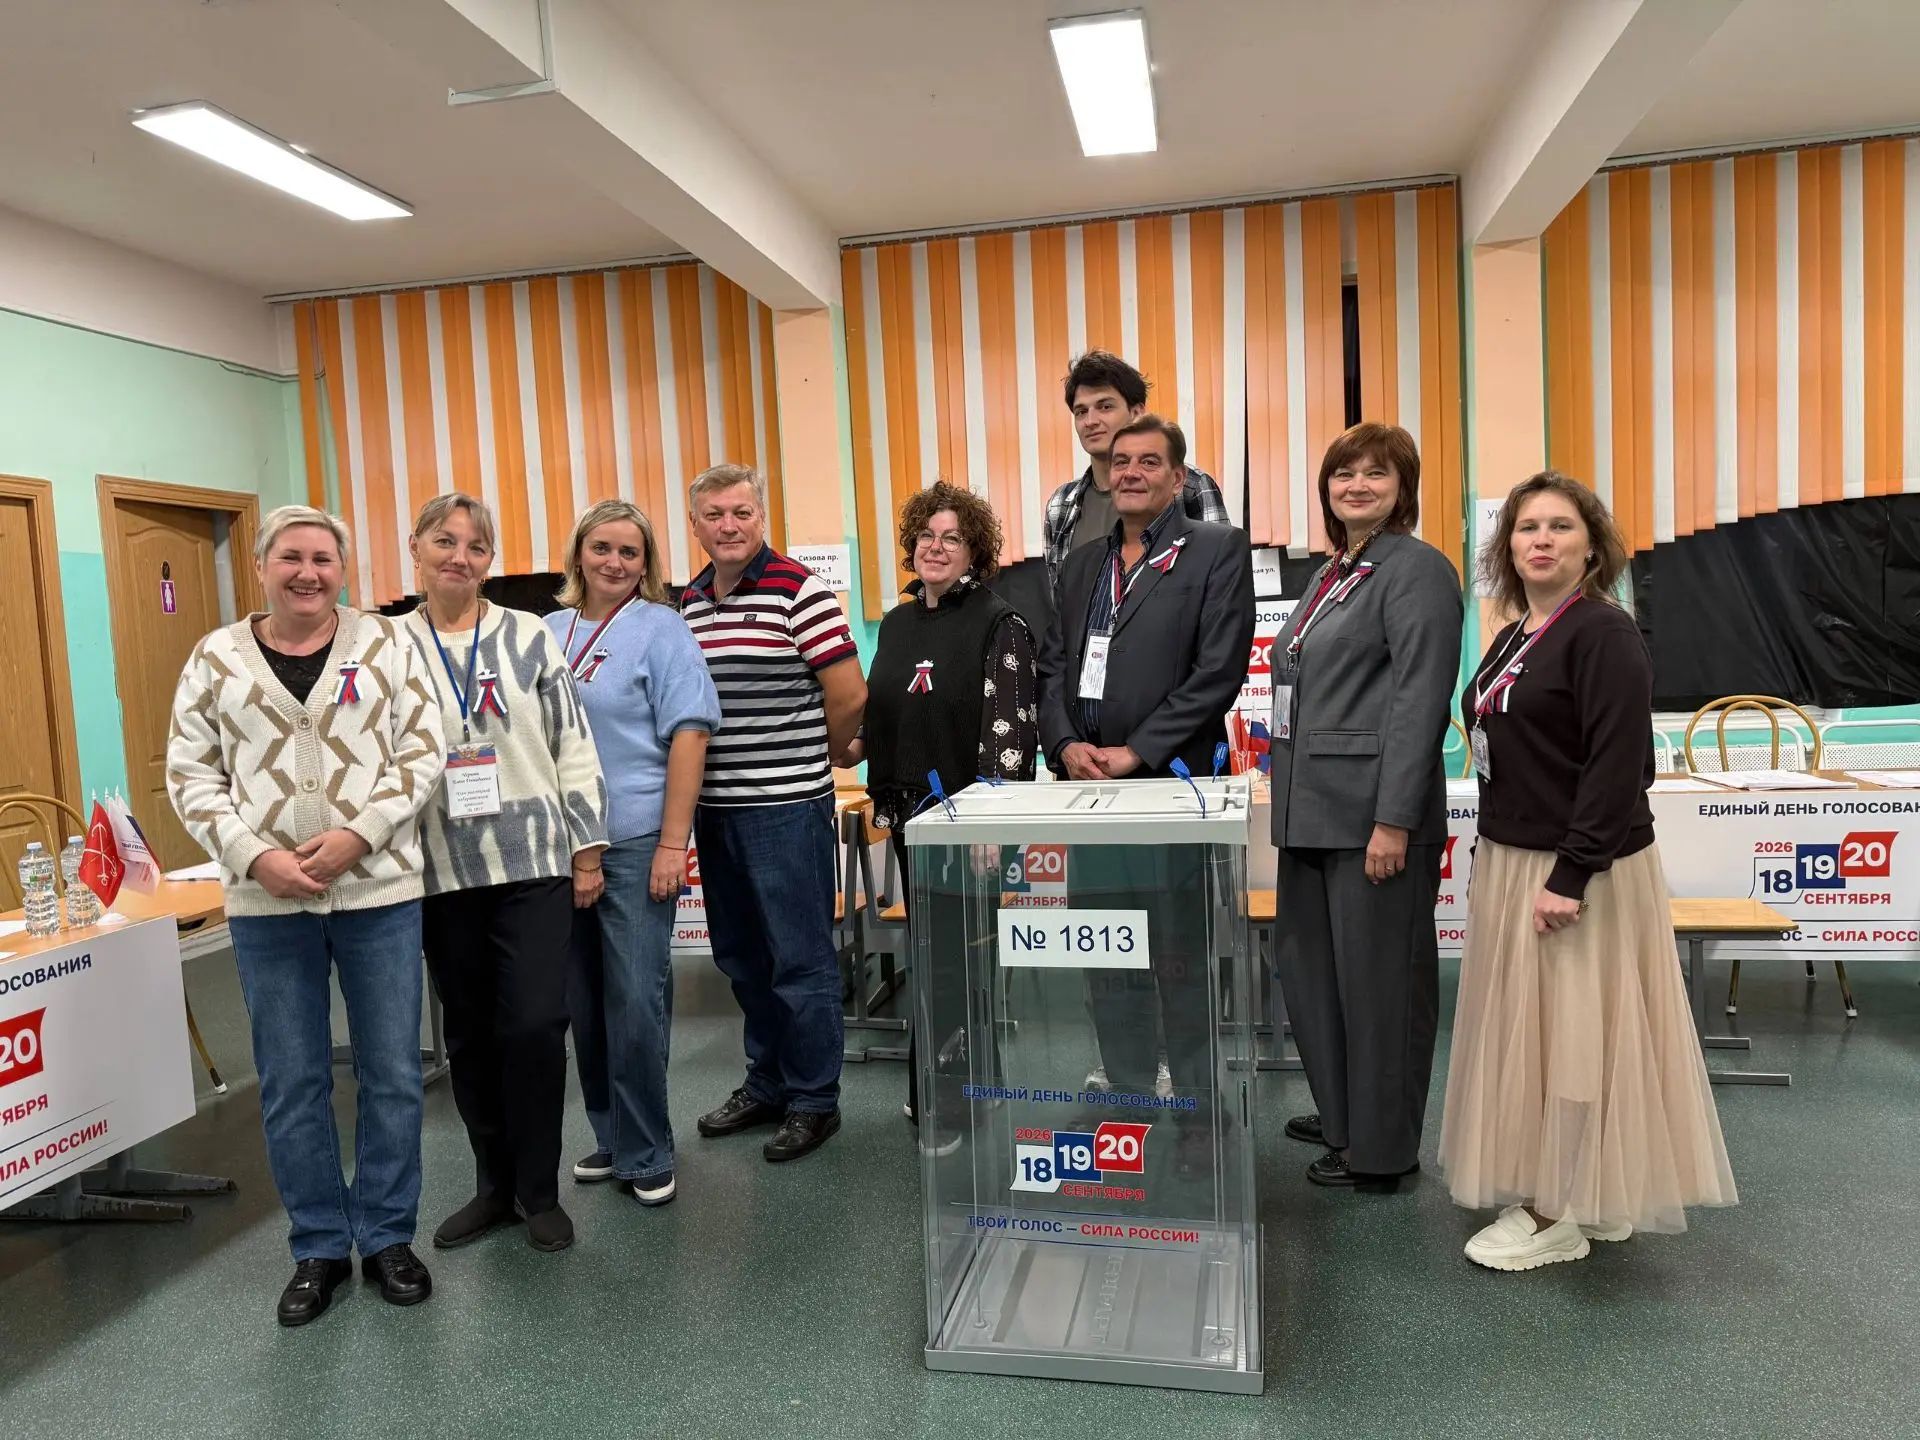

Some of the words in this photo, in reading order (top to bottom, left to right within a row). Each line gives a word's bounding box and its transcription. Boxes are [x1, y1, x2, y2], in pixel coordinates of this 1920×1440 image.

[1265, 567, 1276, 575] ул.
[1699, 801, 1769, 817] ЕДИНЫЙ
[1773, 803, 1818, 816] ДЕНЬ
[1027, 851, 1062, 874] 20
[1754, 842, 1793, 853] 2026
[1843, 842, 1887, 867] 20
[1759, 869, 1793, 894] 18
[1800, 855, 1836, 880] 19
[678, 899, 705, 908] НТЯ
[1804, 893, 1891, 904] СЕНТЯБРЯ
[1011, 924, 1046, 951] №
[1059, 925, 1135, 953] 1813
[1822, 930, 1868, 942] СИЛА
[1873, 930, 1920, 942] РОСС
[0, 1028, 38, 1073] 20
[962, 1085, 1028, 1100] ЕДИНЫЙ
[1032, 1089, 1073, 1104] ДЕНЬ
[1077, 1092, 1197, 1110] ГОЛОСОВАНИЯ
[0, 1094, 49, 1127] ЯБРЯ
[34, 1119, 109, 1166] РОССИИ!
[1015, 1128, 1051, 1141] 2026
[1098, 1134, 1139, 1161] 20
[1020, 1156, 1053, 1183] 18
[1058, 1144, 1092, 1171] 19
[1062, 1184, 1146, 1201] СЕНТЯБРЯ
[967, 1214, 1007, 1230] ТВОЙ
[1012, 1218, 1063, 1233] ГОЛОС
[1081, 1223, 1124, 1238] СИЛА
[1129, 1227, 1200, 1243] РОССИИ!
